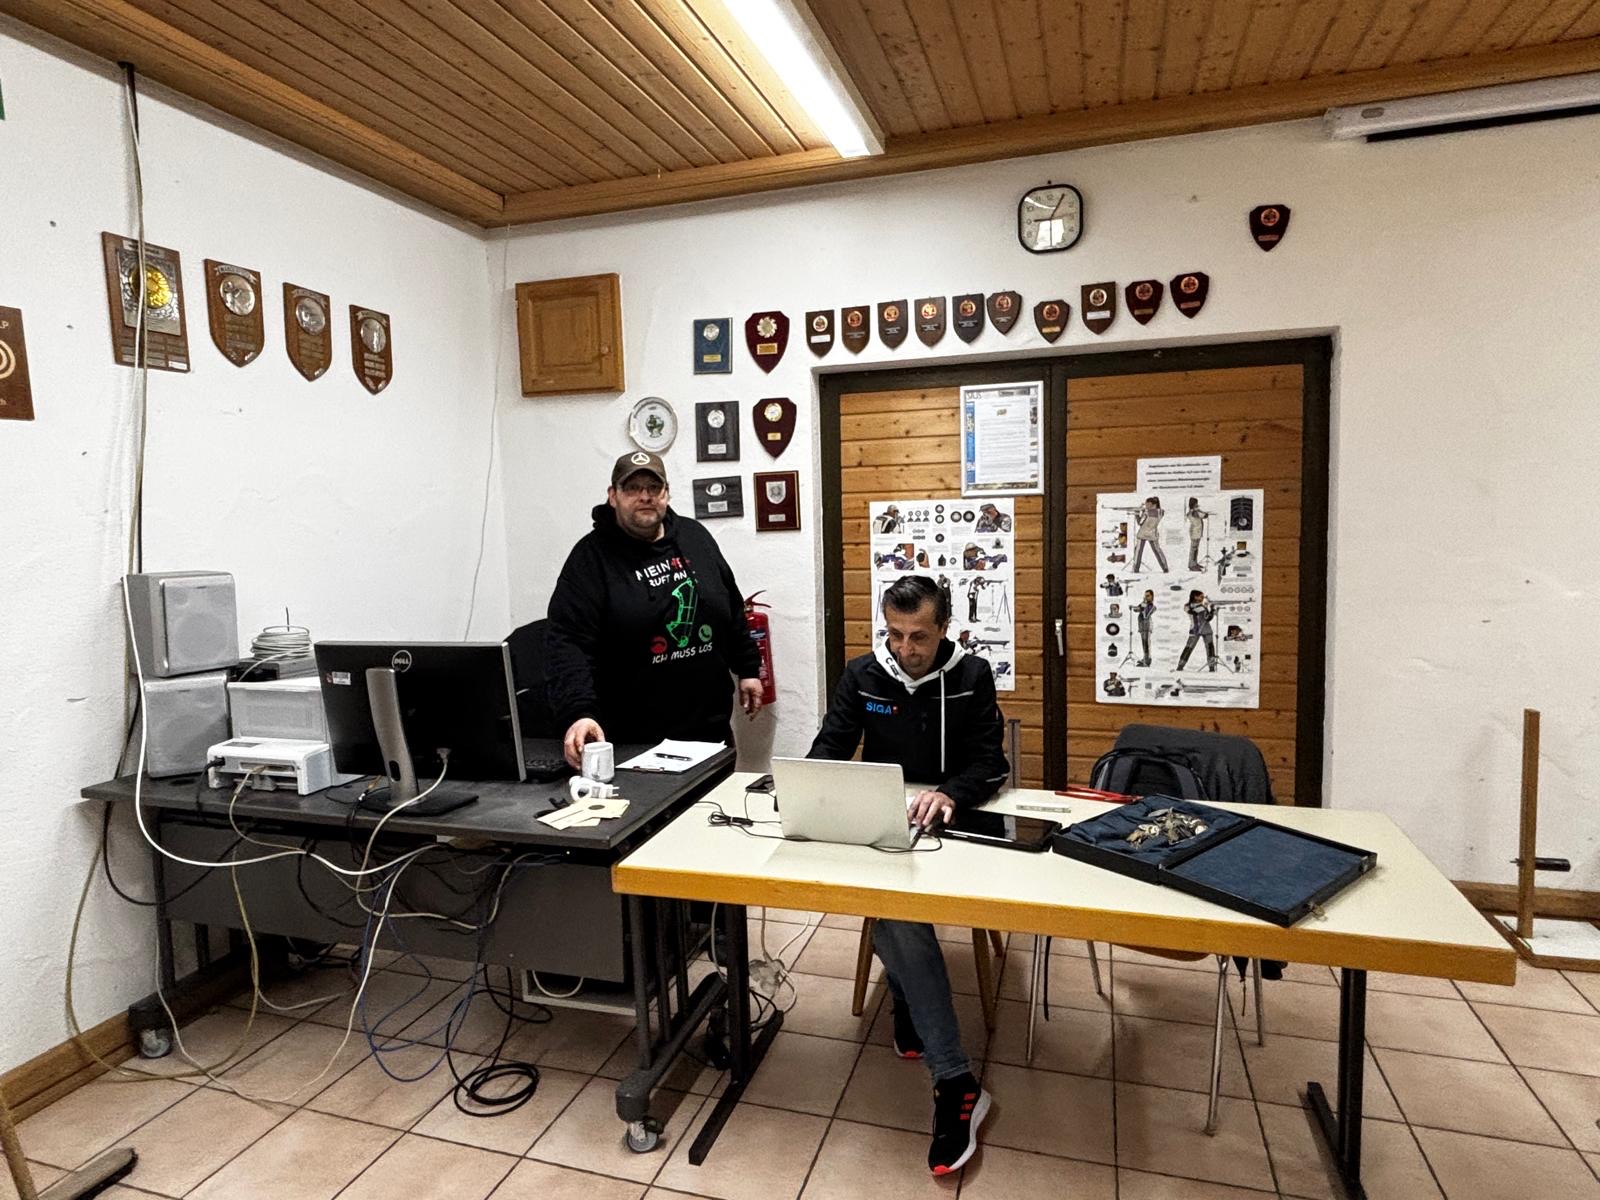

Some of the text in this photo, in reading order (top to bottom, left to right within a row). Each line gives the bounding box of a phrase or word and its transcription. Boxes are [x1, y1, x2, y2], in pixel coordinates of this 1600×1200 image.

[673, 569, 688, 582] AN
[652, 642, 713, 664] ICH MUSS LOS
